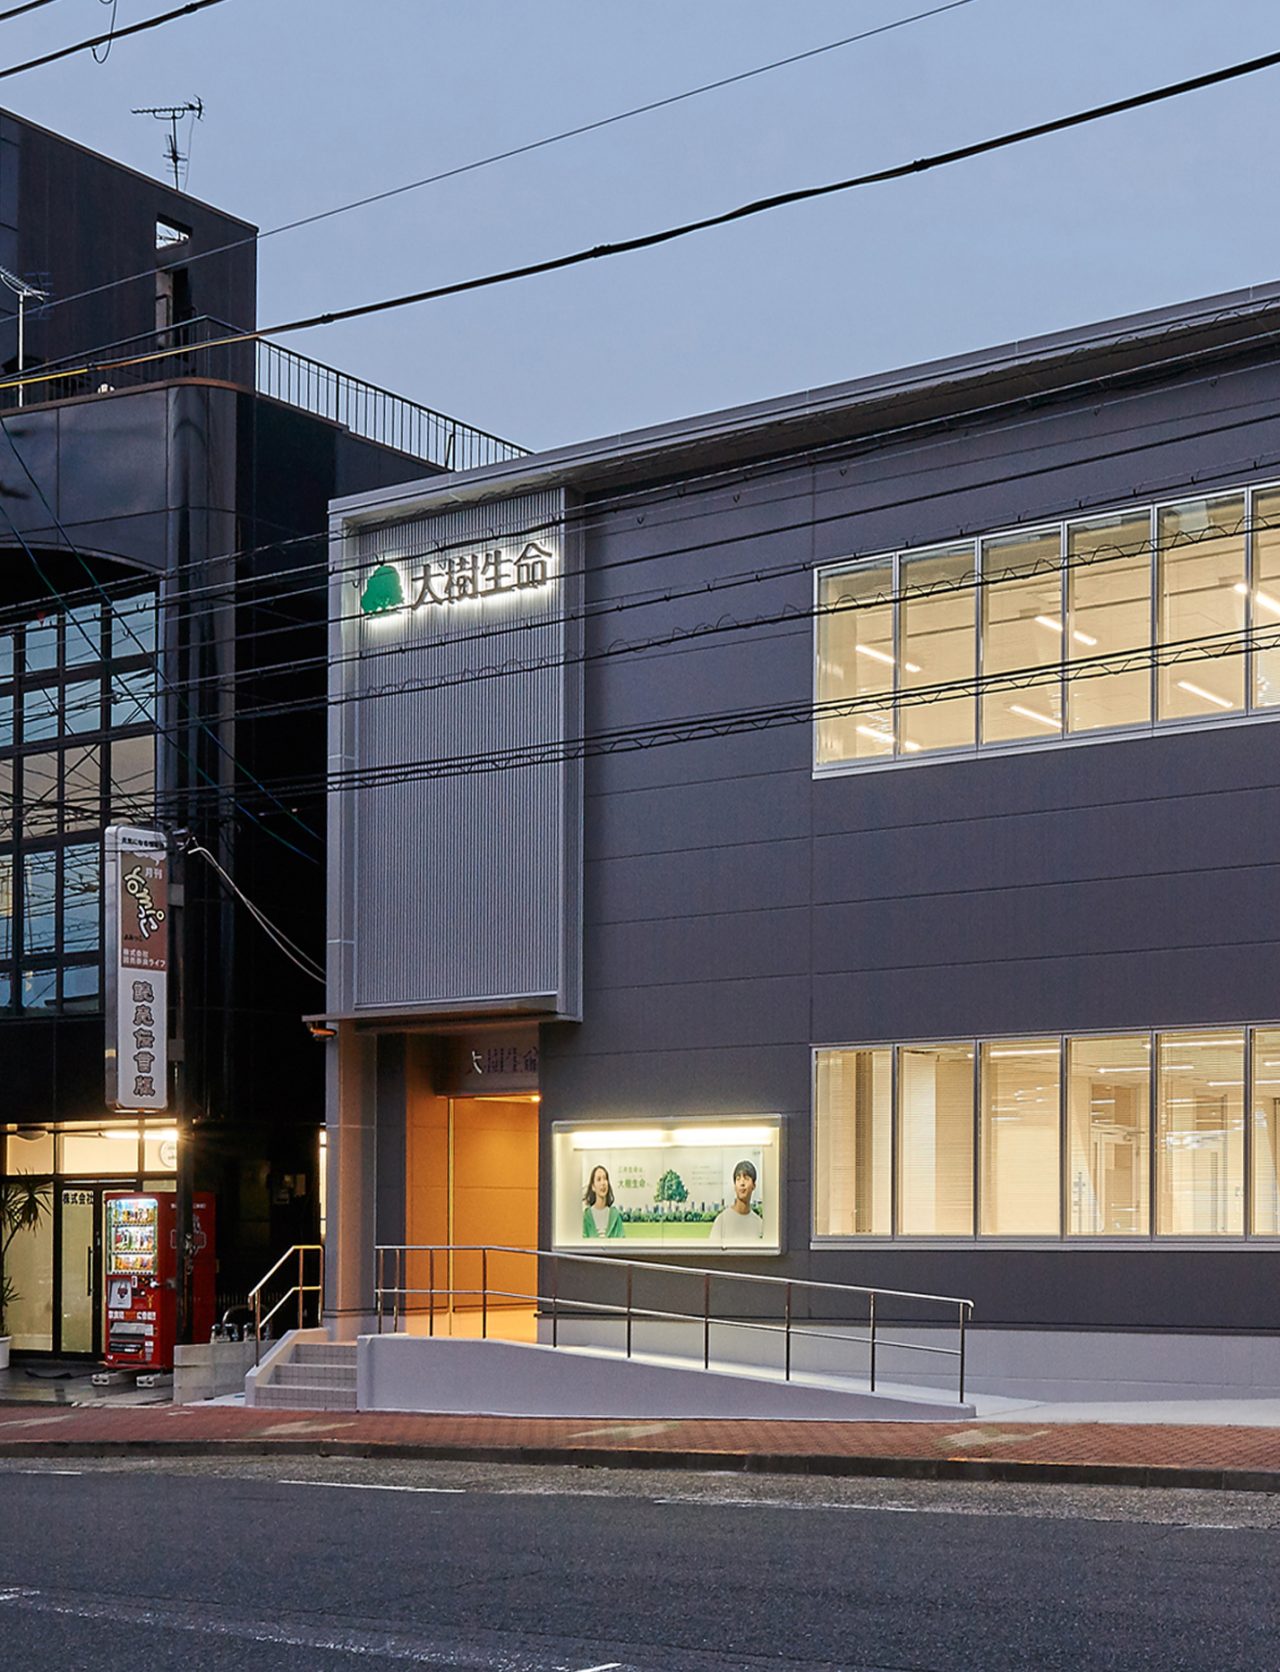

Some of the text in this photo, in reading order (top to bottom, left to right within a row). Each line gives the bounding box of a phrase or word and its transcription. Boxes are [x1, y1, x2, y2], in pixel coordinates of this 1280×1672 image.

[411, 542, 552, 610] 大樹生命
[145, 867, 163, 879] 月刊
[122, 948, 149, 958] 株式会社
[63, 1192, 94, 1205] 株式会社
